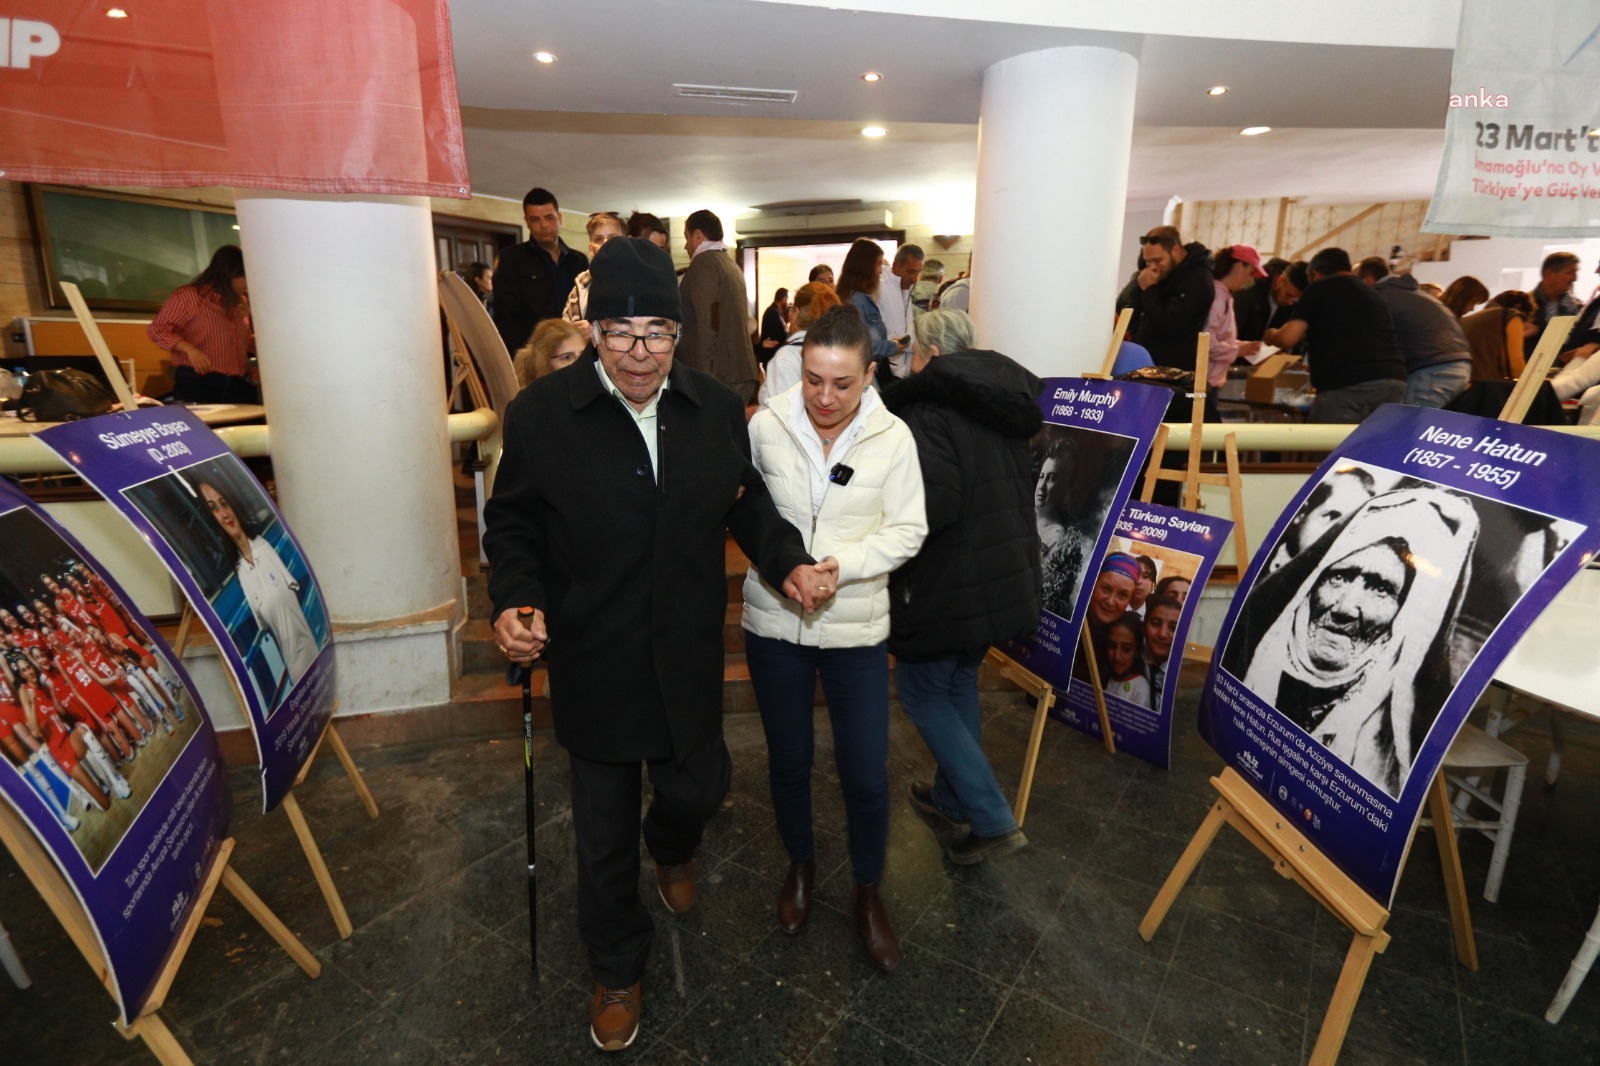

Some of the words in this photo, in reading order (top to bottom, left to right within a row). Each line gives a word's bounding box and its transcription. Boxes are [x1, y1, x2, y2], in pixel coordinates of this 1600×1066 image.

[1568, 161, 1588, 179] Oy
[1472, 178, 1543, 201] Türkiye'ye
[1547, 182, 1578, 200] Güç
[1053, 388, 1078, 403] Emily
[1078, 390, 1120, 408] Murphy
[1080, 408, 1104, 423] 1933)
[98, 427, 160, 450] Sümeyye
[1419, 425, 1473, 449] Nene
[1472, 436, 1547, 467] Hatun
[1403, 447, 1455, 469] (1857
[1466, 462, 1521, 490] 1955)
[1116, 521, 1134, 531] 935
[1140, 525, 1168, 541] 2009)
[1129, 508, 1166, 525] Türkan
[1168, 516, 1210, 535] Saylan
[1216, 673, 1224, 684] 93
[1223, 679, 1239, 697] Harbi
[1239, 694, 1266, 719] sırasında
[1266, 713, 1306, 751] Erzurum'da
[1306, 746, 1333, 772] Aziziye
[1334, 769, 1393, 819] savunmasına
[1230, 699, 1246, 718] Nene
[1267, 730, 1281, 747] Rus
[1282, 741, 1309, 769] işgaline
[1309, 764, 1328, 786] karşı
[1329, 780, 1389, 833] Erzurum'daki
[1232, 715, 1246, 732] halk
[1277, 755, 1306, 782] simgesi
[1306, 779, 1342, 813] olmuştur.
